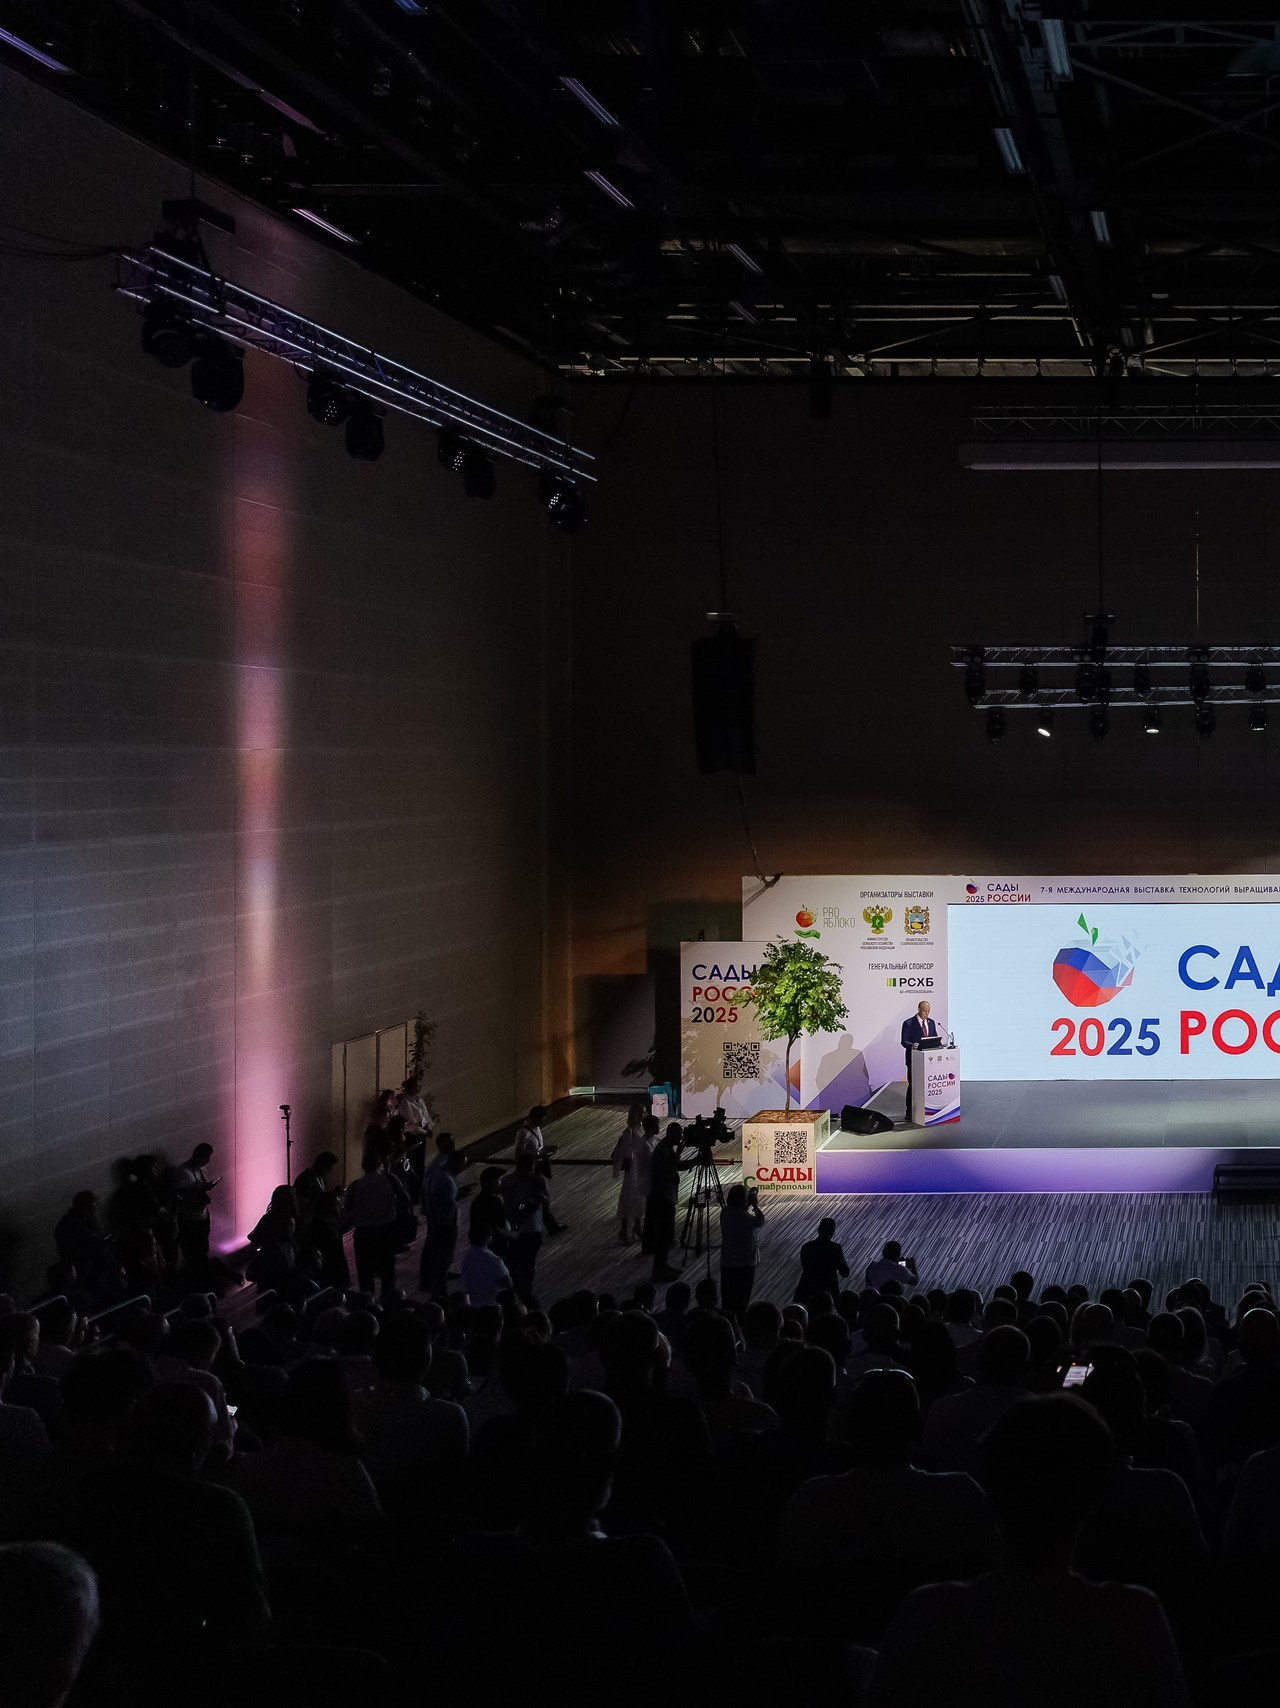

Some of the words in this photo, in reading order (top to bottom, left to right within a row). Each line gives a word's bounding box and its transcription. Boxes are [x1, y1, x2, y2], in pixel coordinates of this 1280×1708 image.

[987, 883, 1019, 892] САДЫ
[1040, 886, 1053, 894] 7-Я
[1056, 886, 1130, 894] МЕЖДУНАРОДНАЯ
[1134, 886, 1175, 894] ВЫСТАВКА
[1179, 885, 1230, 893] ТЕХНОЛОГИЙ
[965, 895, 984, 903] 2025
[987, 894, 1031, 902] РОССИИ
[823, 917, 856, 928] ЯБЛОКО
[868, 962, 907, 970] ГЕНЕРАЛЬНЫЙ
[691, 964, 757, 982] САДЫ
[899, 977, 934, 987] РСХБ
[691, 1006, 738, 1023] 2025
[1050, 1017, 1161, 1056] 2025
[927, 1073, 948, 1082] САДЫ
[927, 1080, 956, 1089] РОССИИ
[927, 1089, 943, 1097] 2025
[755, 1167, 813, 1182] САДЫ
